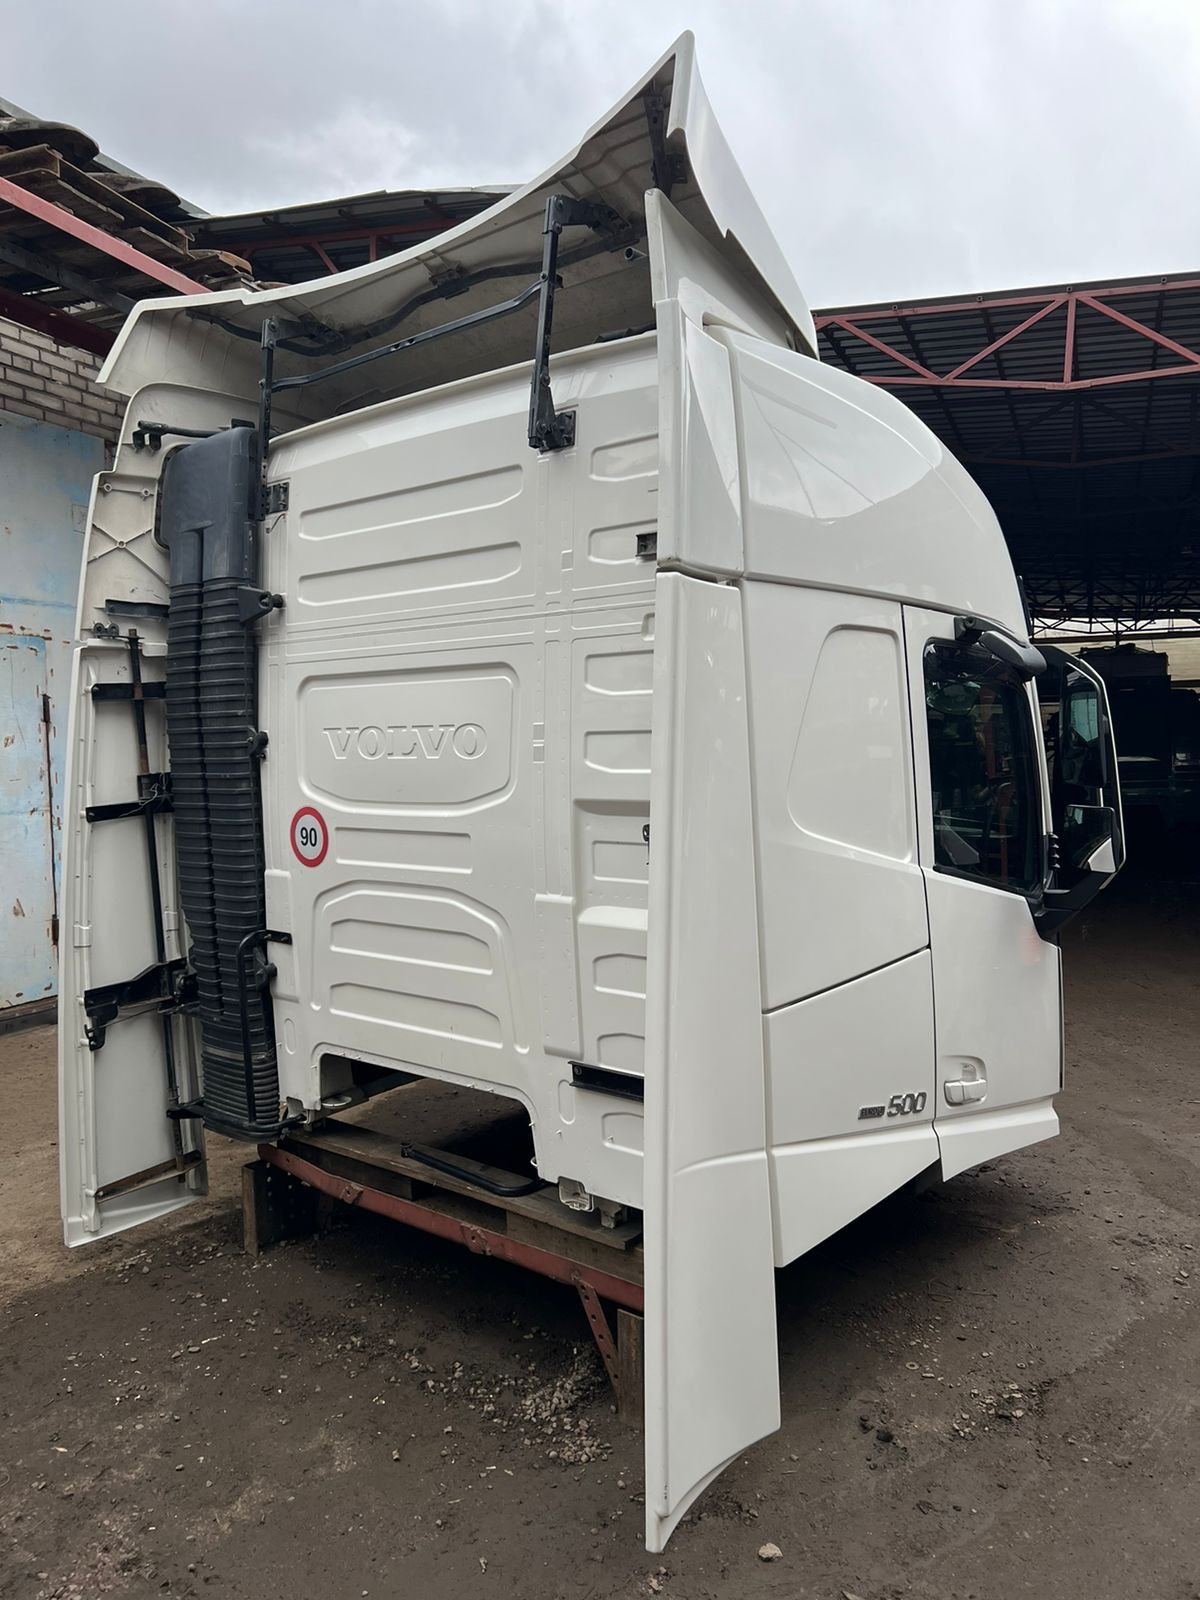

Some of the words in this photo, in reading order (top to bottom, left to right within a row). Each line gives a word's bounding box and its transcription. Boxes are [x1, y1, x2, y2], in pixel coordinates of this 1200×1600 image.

[322, 723, 487, 760] VOLVO
[300, 826, 317, 847] 90
[886, 1092, 927, 1117] 500
